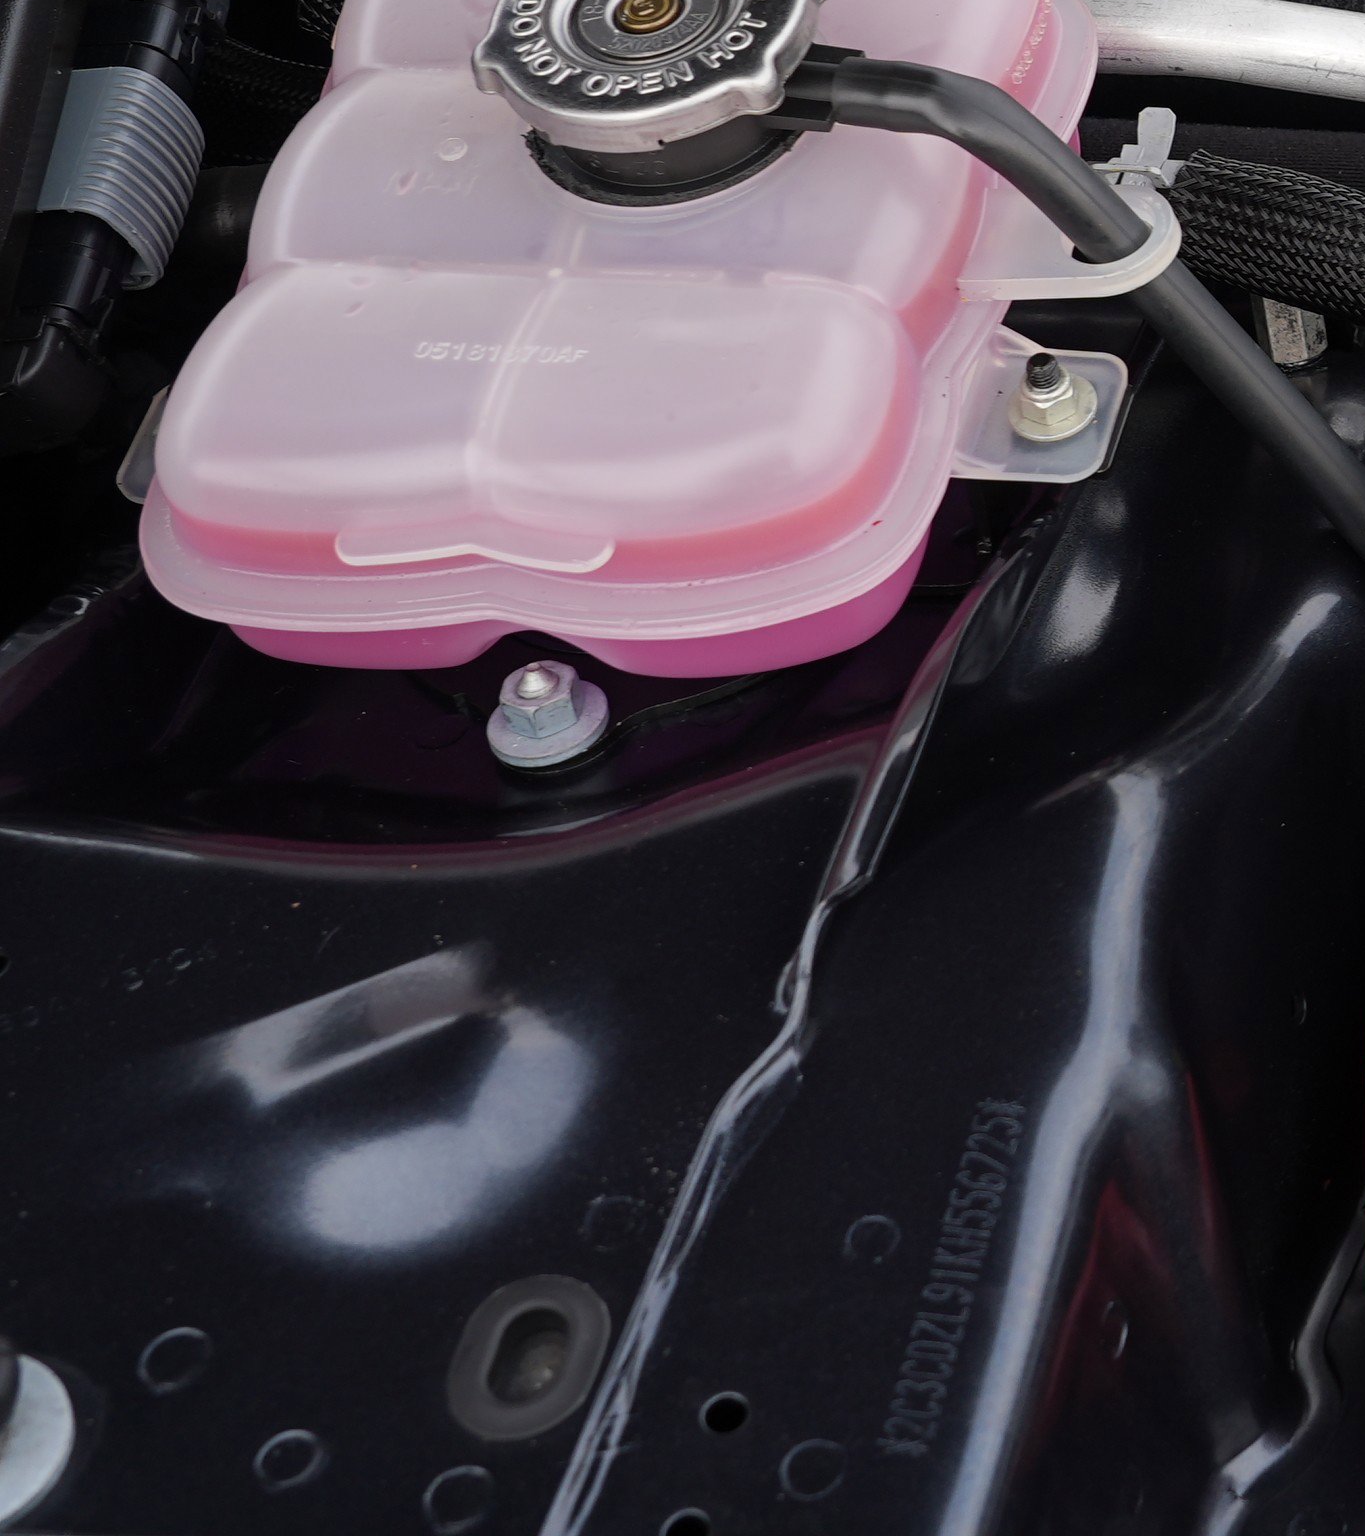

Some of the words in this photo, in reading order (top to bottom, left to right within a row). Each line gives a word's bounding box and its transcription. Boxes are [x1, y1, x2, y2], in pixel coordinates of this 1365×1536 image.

[514, 37, 582, 85] NOT
[581, 60, 695, 97] OPEN
[697, 11, 767, 70] HOT
